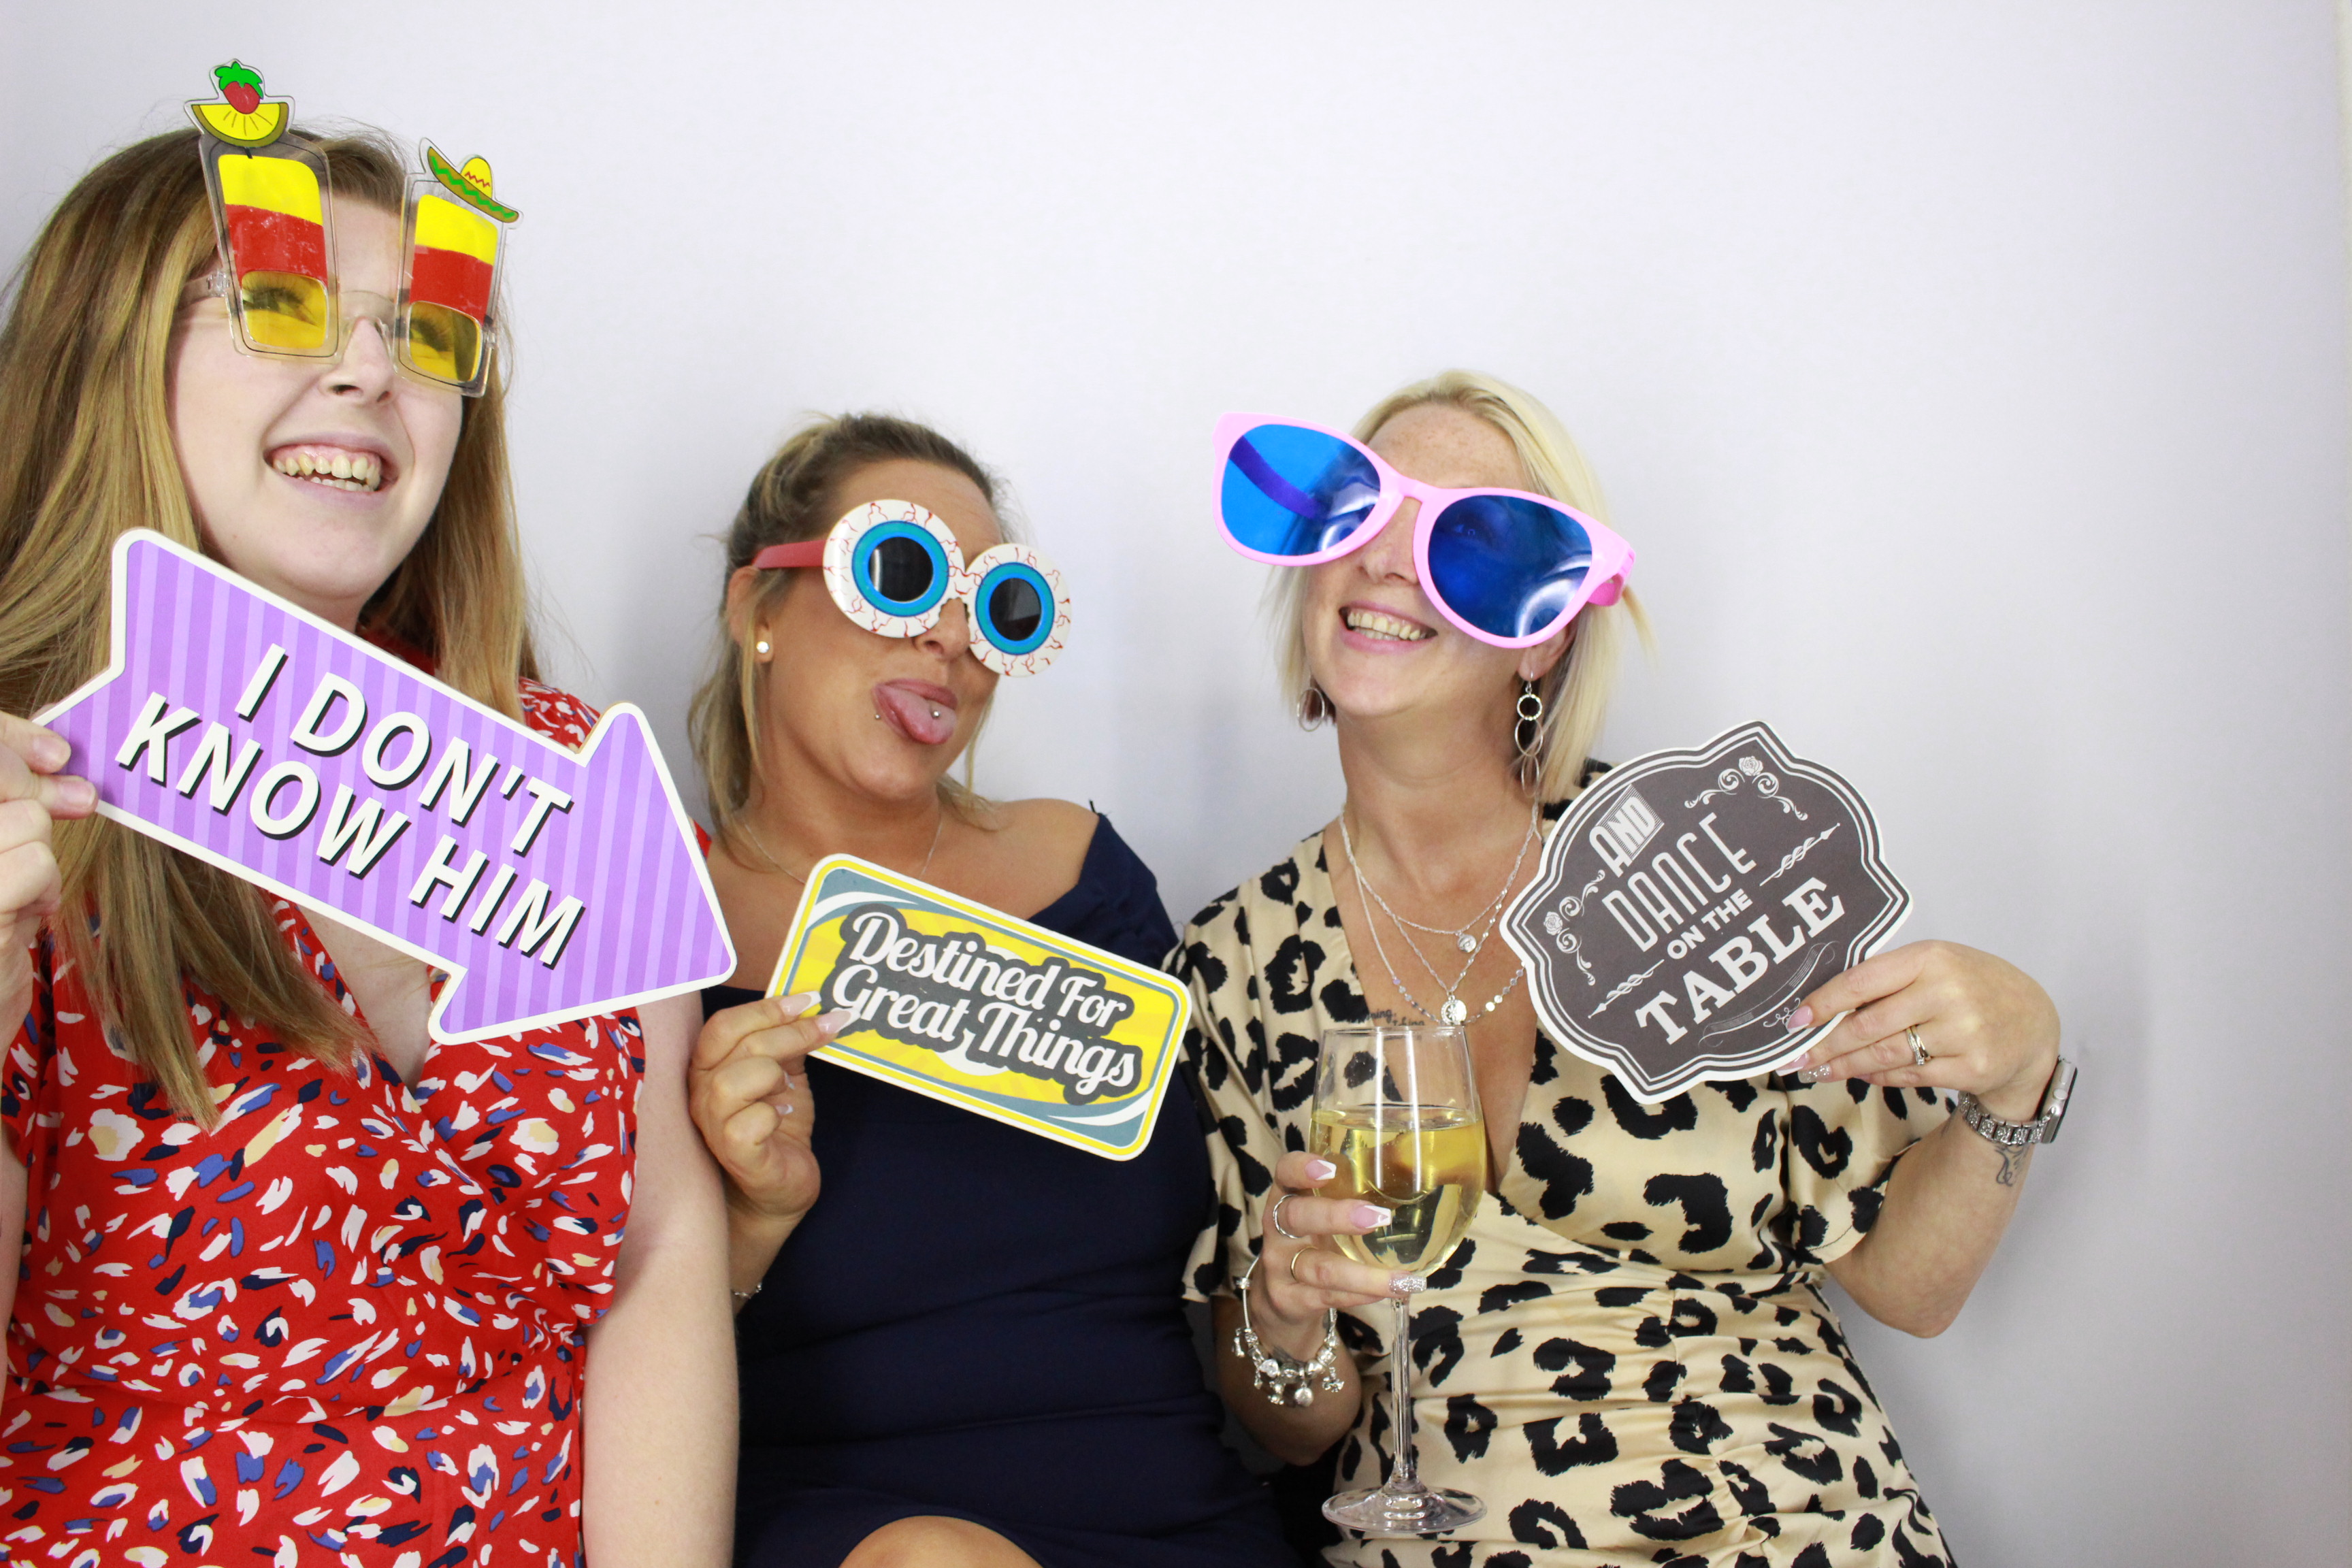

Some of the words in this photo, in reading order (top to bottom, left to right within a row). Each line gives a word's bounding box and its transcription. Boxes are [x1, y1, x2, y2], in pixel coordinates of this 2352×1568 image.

[235, 643, 289, 721] I
[290, 672, 575, 857] DON'T
[114, 691, 412, 879] KNOW
[408, 834, 587, 968] HIM
[1589, 793, 1659, 878] AND
[1601, 812, 1757, 953] DANCE
[849, 912, 1062, 1011] Destined
[1060, 975, 1128, 1028] For
[1635, 877, 1846, 1045] TABLE
[1667, 926, 1706, 960] ON
[1701, 888, 1754, 936] THE
[833, 965, 970, 1041] Great
[977, 1001, 1136, 1096] Things
